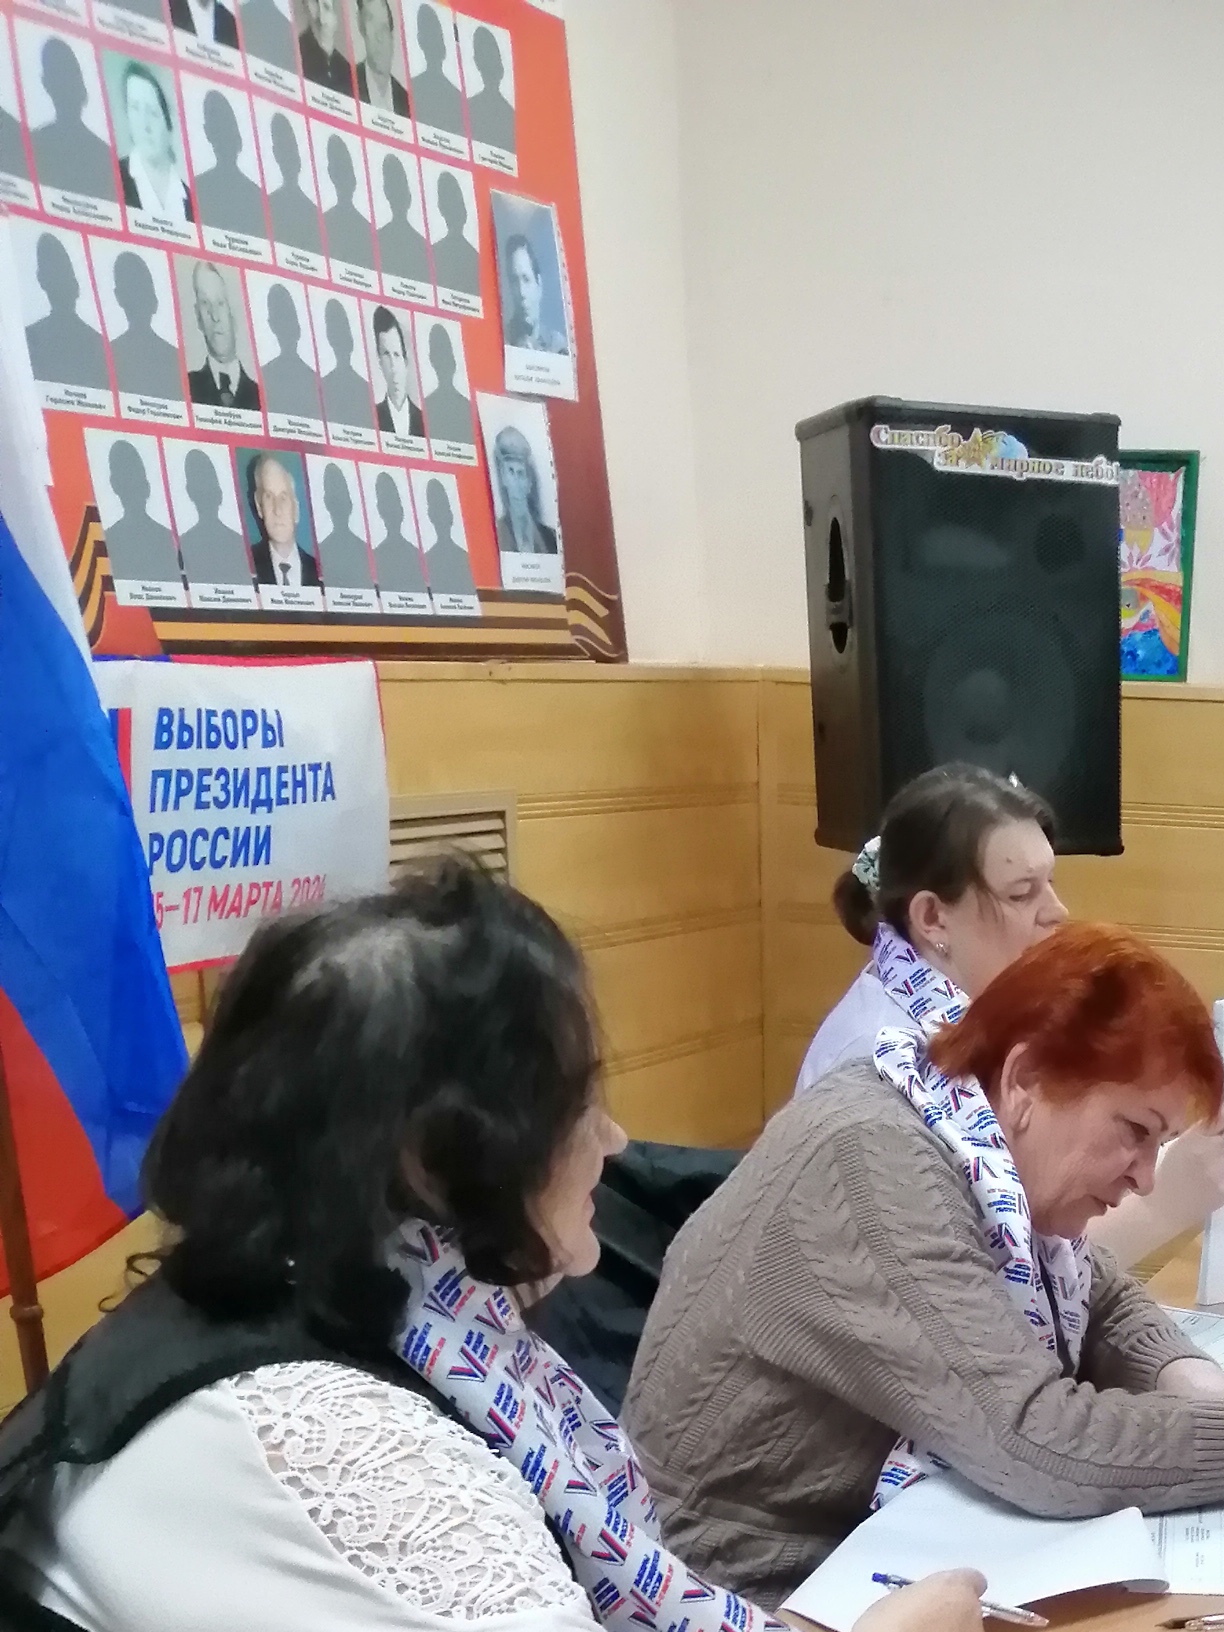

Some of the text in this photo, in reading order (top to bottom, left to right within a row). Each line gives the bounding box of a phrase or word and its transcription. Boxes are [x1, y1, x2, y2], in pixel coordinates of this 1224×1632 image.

[154, 707, 284, 750] ВЫБОРЫ
[149, 761, 336, 814] ПРЕЗИДЕНТА
[148, 825, 271, 876] РОССИИ
[207, 880, 283, 920] МАРТА
